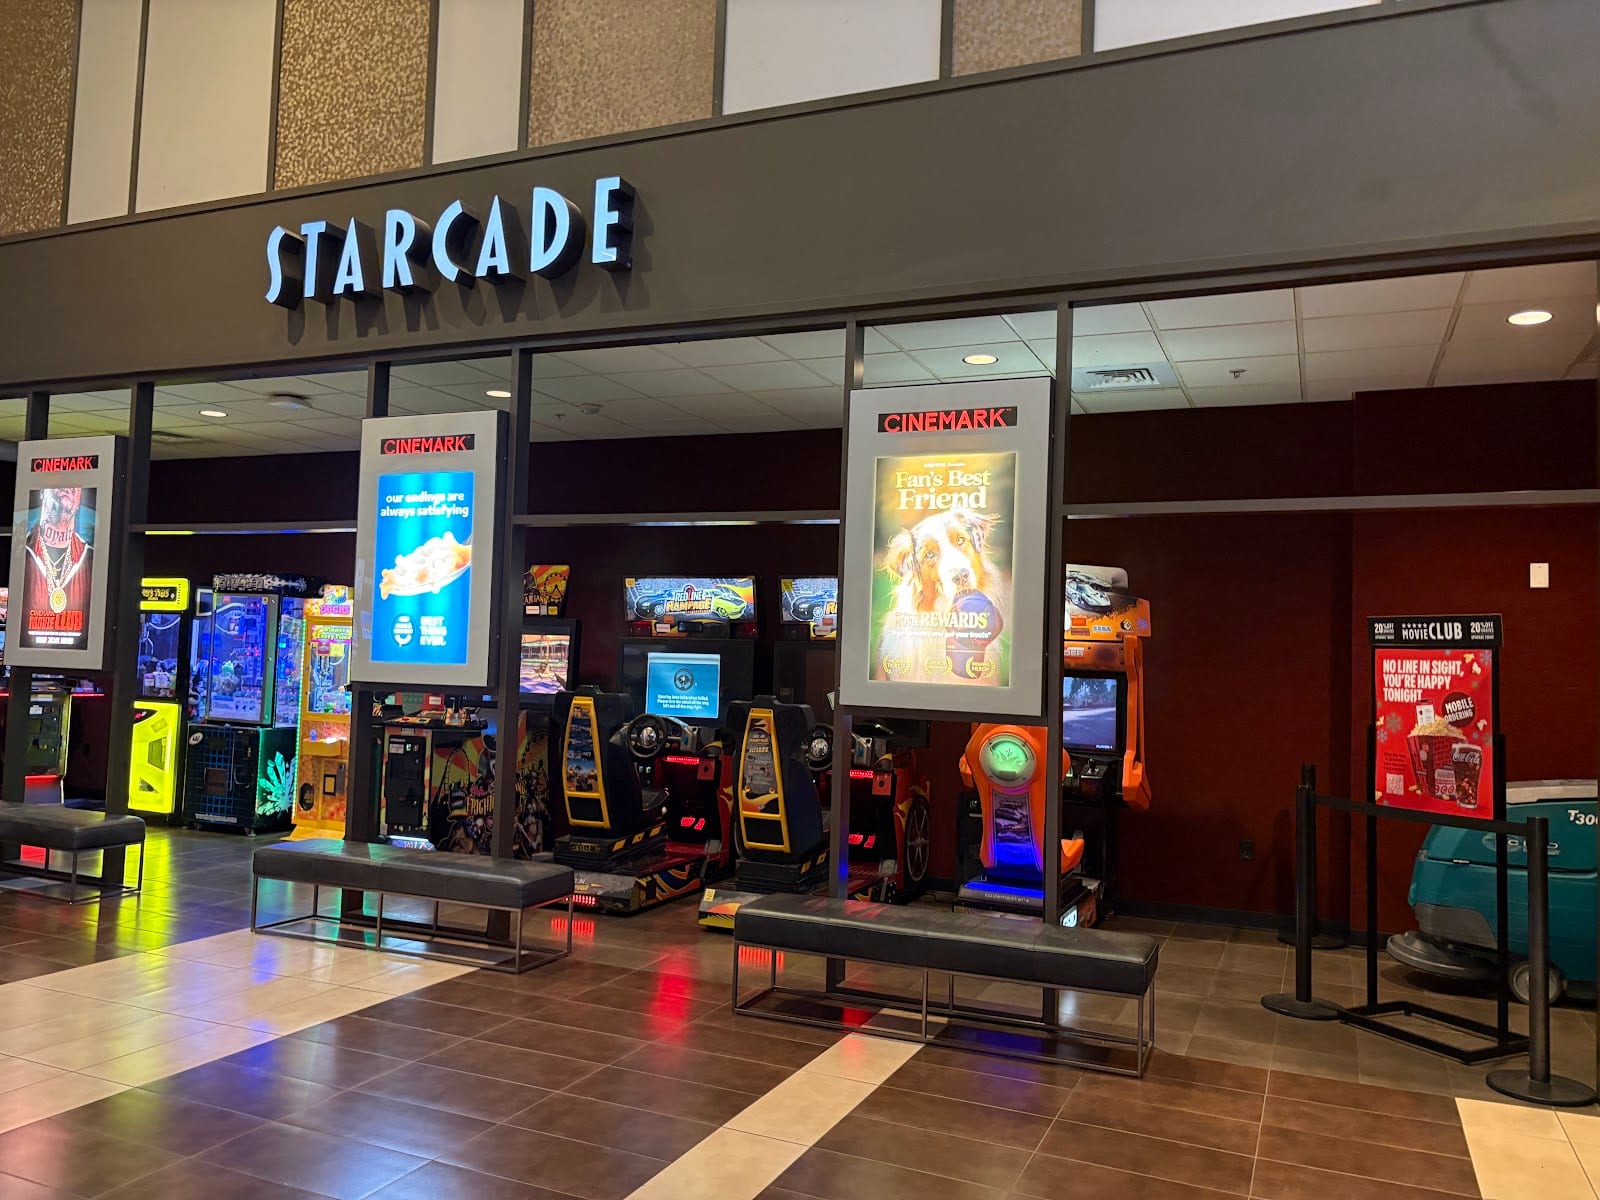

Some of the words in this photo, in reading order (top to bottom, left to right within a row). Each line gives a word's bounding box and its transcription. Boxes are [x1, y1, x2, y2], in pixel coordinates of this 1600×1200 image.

[265, 176, 621, 304] STARCADE
[884, 408, 1007, 433] CINEMARK
[384, 436, 467, 455] CINEMARK
[33, 456, 93, 473] CINEMARK
[895, 471, 943, 488] Fan's
[947, 469, 992, 487] Best
[386, 494, 404, 503] our
[447, 493, 465, 502] are
[897, 486, 988, 510] Friend
[380, 506, 416, 519] always
[417, 504, 470, 518] satisfying
[55, 610, 83, 631] CLUB
[921, 612, 988, 629] REWARDS
[1402, 629, 1428, 639] MOVIE
[1429, 622, 1463, 640] CLUB
[1383, 659, 1397, 673] NO
[1397, 659, 1418, 674] LINE
[1420, 660, 1430, 674] IN
[1431, 660, 1464, 677] SIGHT,
[1383, 674, 1416, 688] YOU'RE
[1417, 675, 1451, 690] HAPPY
[1445, 697, 1474, 713] MOBILE
[1444, 708, 1473, 722] ORDERING
[1567, 809, 1598, 826] T30
